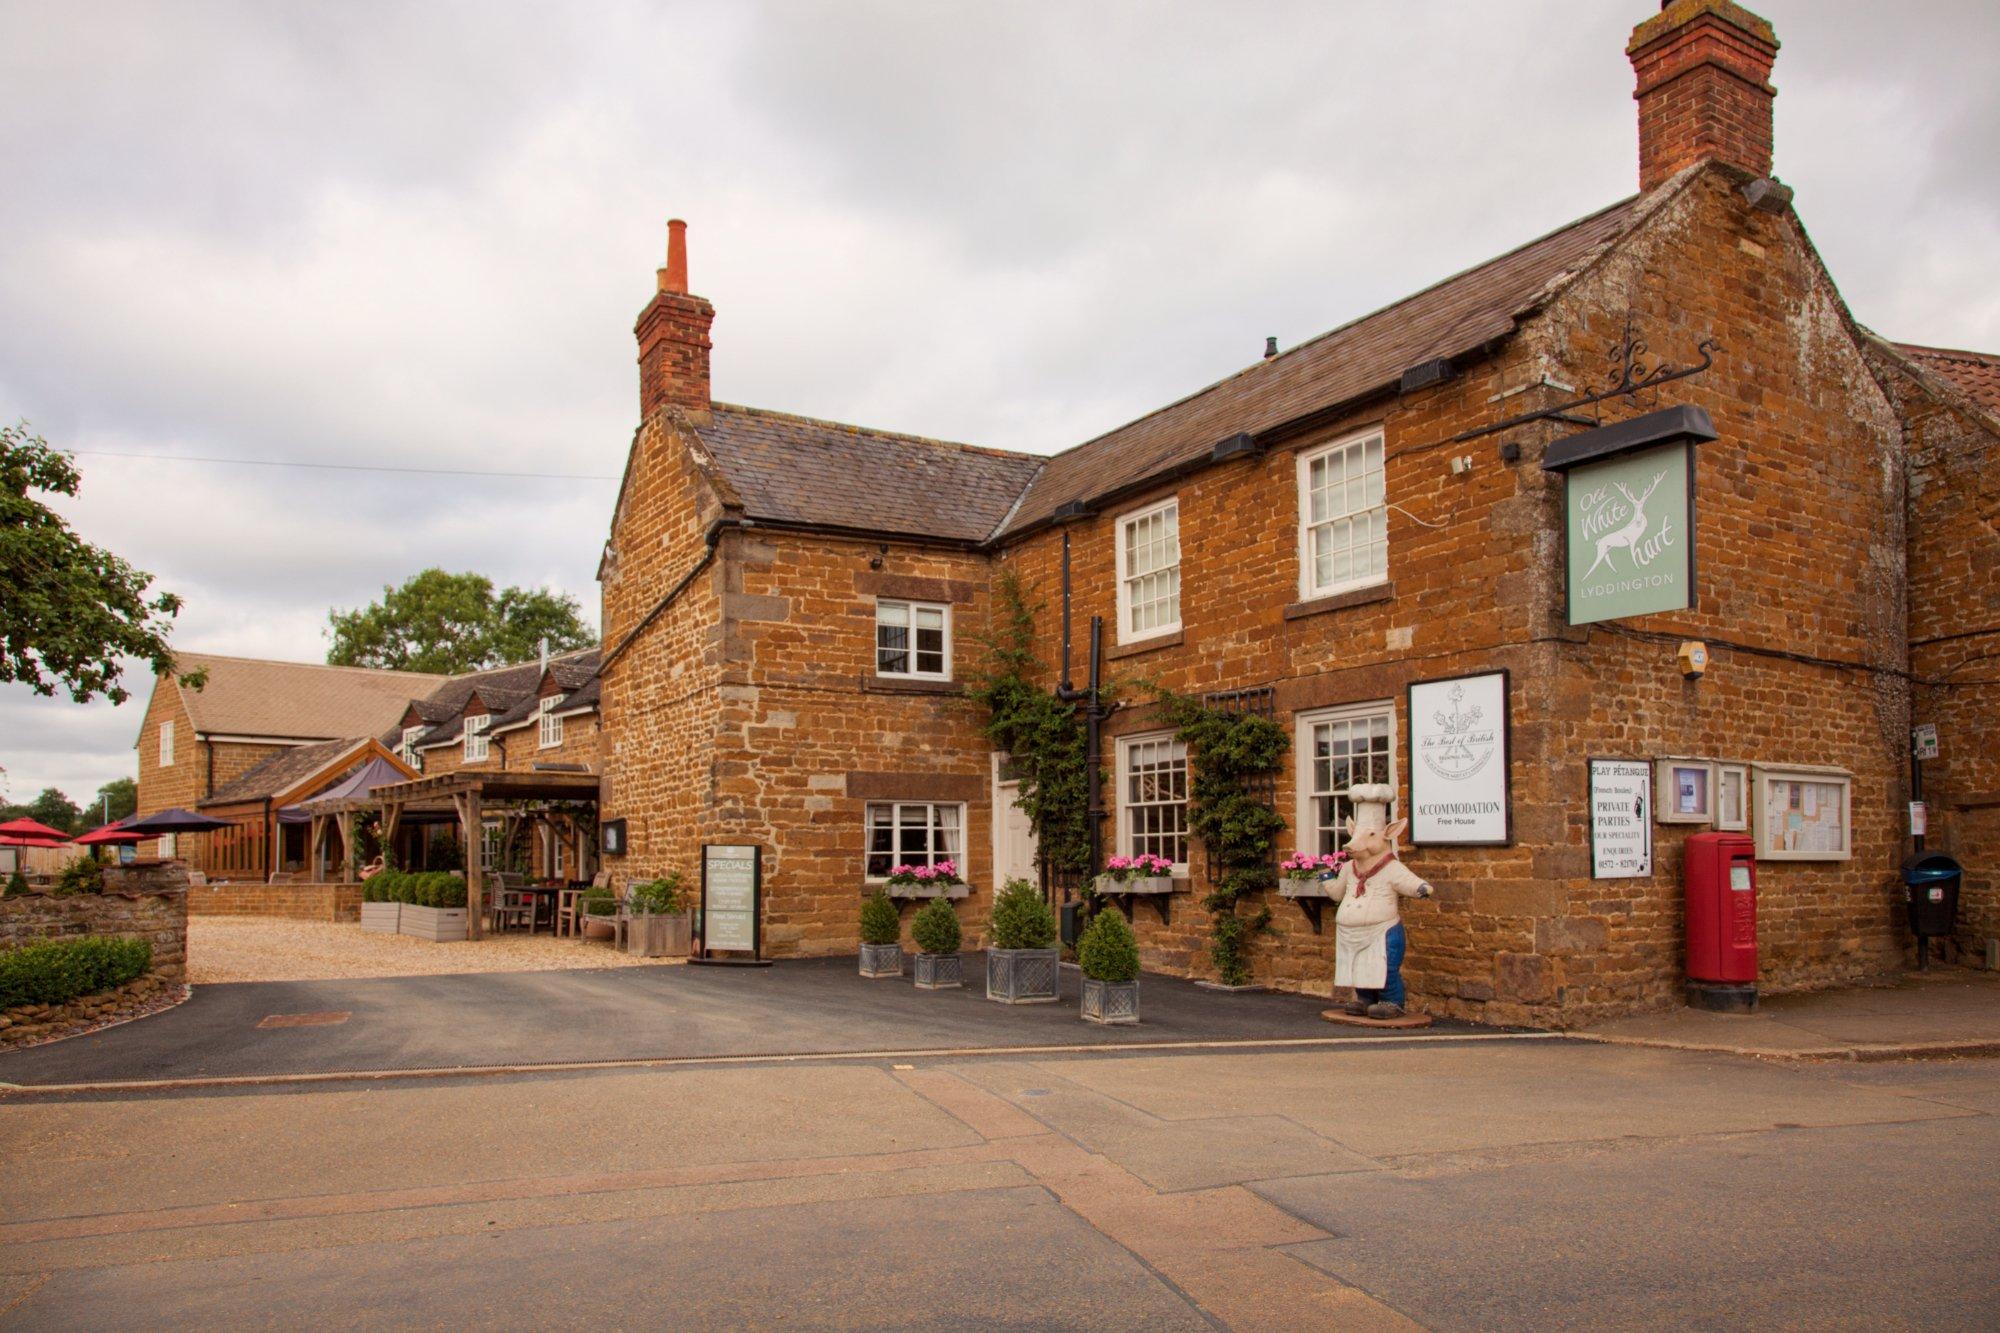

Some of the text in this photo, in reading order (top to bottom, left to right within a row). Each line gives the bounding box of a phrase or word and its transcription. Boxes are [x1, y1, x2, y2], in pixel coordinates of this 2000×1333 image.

[1580, 483, 1607, 512] Old
[1580, 496, 1628, 541] White
[1633, 515, 1675, 569] hart
[1581, 573, 1674, 598] LYDDINGTON
[1421, 732, 1494, 747] The Best of British
[1592, 764, 1649, 777] PLAY PÉTANQUE
[1418, 802, 1500, 815] ACCOMMODATION
[1597, 802, 1630, 812] PRIVATE
[1598, 817, 1630, 826] PARTIES
[1595, 831, 1640, 839] OUR SPECIALITY
[1602, 847, 1633, 855] ENQUIRIES
[707, 860, 753, 870] SPECIALS
